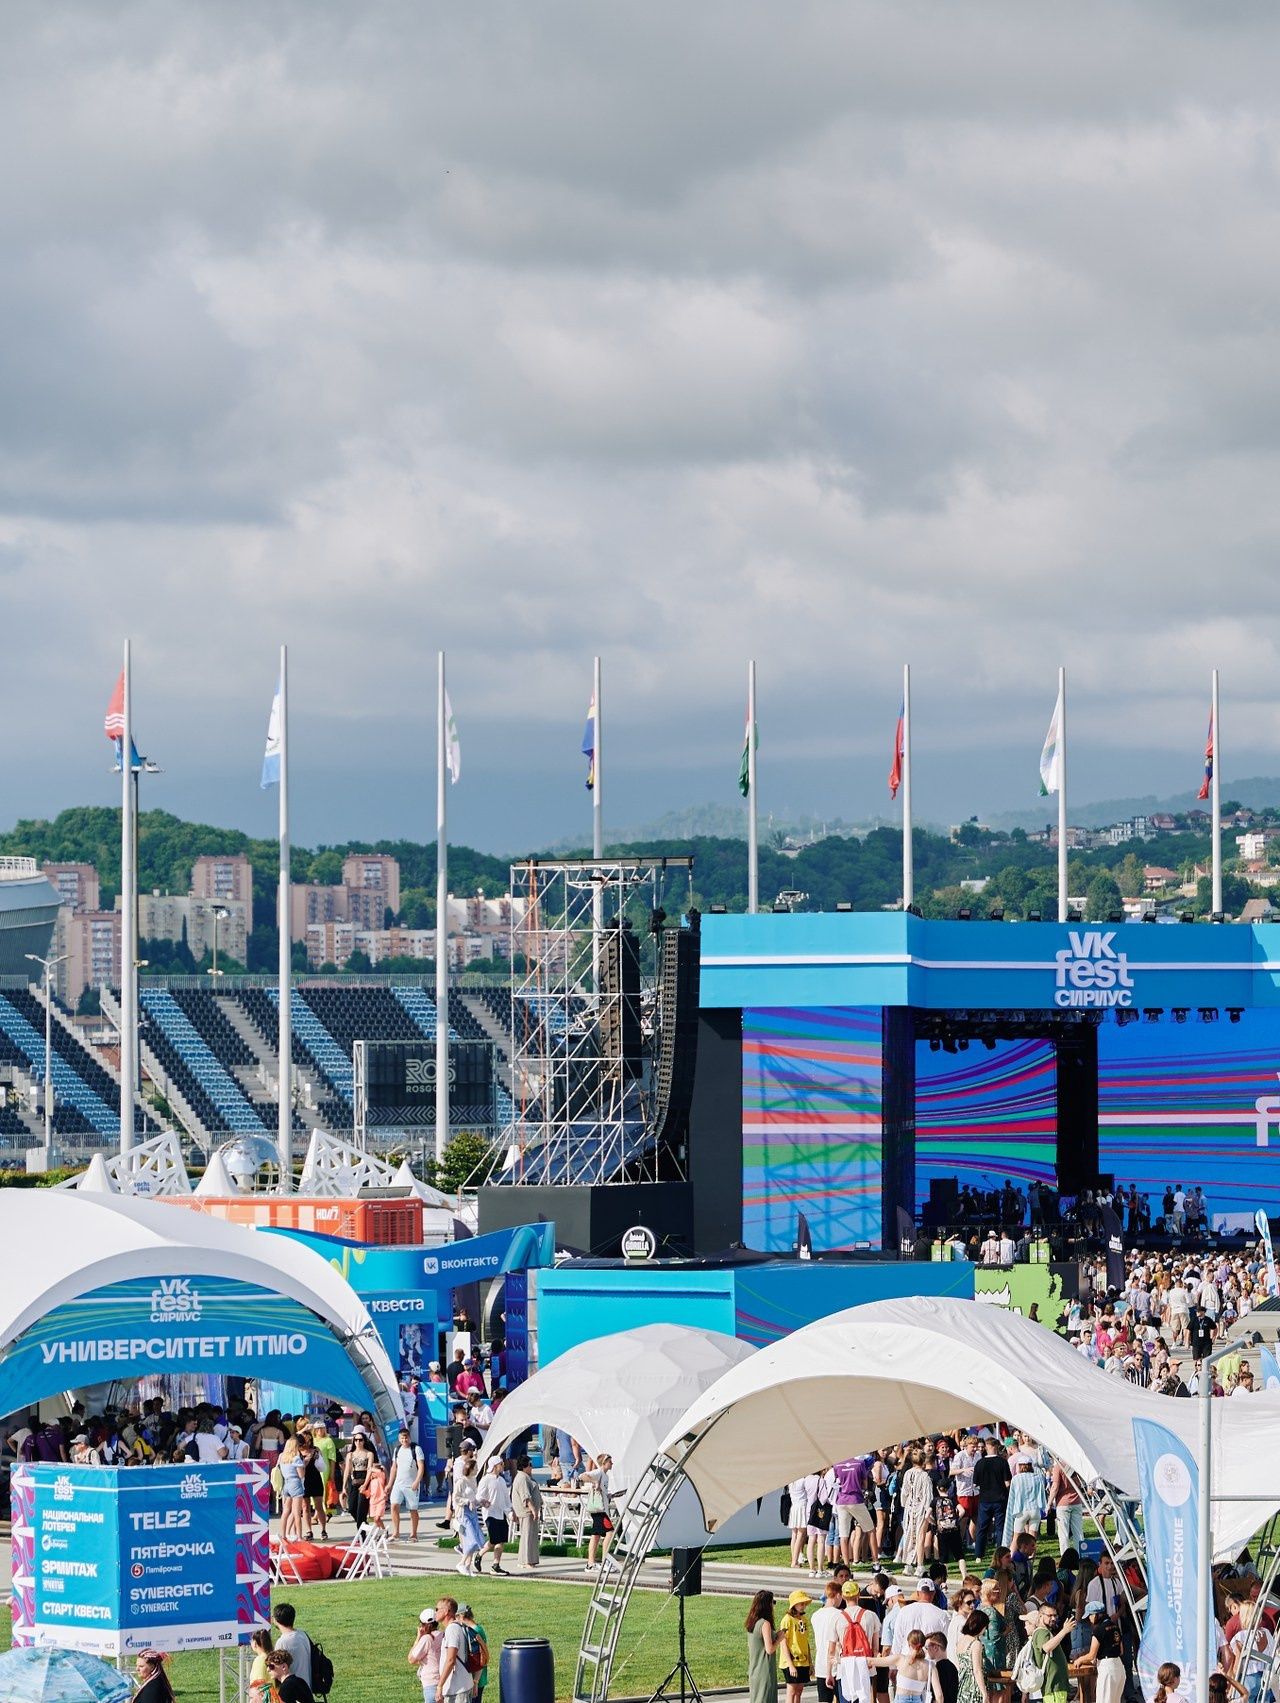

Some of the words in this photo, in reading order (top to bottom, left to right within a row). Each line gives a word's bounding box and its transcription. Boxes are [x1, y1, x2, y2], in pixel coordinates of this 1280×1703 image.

[1068, 931, 1118, 958] VK
[1056, 949, 1135, 988] fest
[1054, 989, 1133, 1007] СИРИУС
[160, 1279, 191, 1295] VK
[150, 1291, 203, 1312] fest
[150, 1311, 201, 1323] СИРИУС
[40, 1336, 230, 1364] УНИВЕРСИТЕТ
[235, 1333, 308, 1356] ИТМО
[57, 1475, 69, 1486] VK
[180, 1479, 208, 1493] fest
[185, 1474, 202, 1484] VK
[54, 1482, 74, 1495] fest
[180, 1491, 208, 1499] СИРИУС
[42, 1510, 104, 1524] НАЦИОНАЛЬНАЯ
[129, 1509, 191, 1531] TELE2
[41, 1522, 76, 1533] ЛОТЕРЕЯ
[130, 1542, 215, 1560] ПЯТЁРОЧКА
[42, 1560, 98, 1577] ЭРМИТАЖ
[145, 1565, 183, 1574] Пятёрочка
[130, 1583, 214, 1600] SYNERGETIC
[42, 1601, 74, 1616] СТАРТ
[74, 1603, 112, 1619] КВЕСТА
[140, 1602, 179, 1613] SYNERGETIC
[218, 1632, 233, 1641] TELE2
